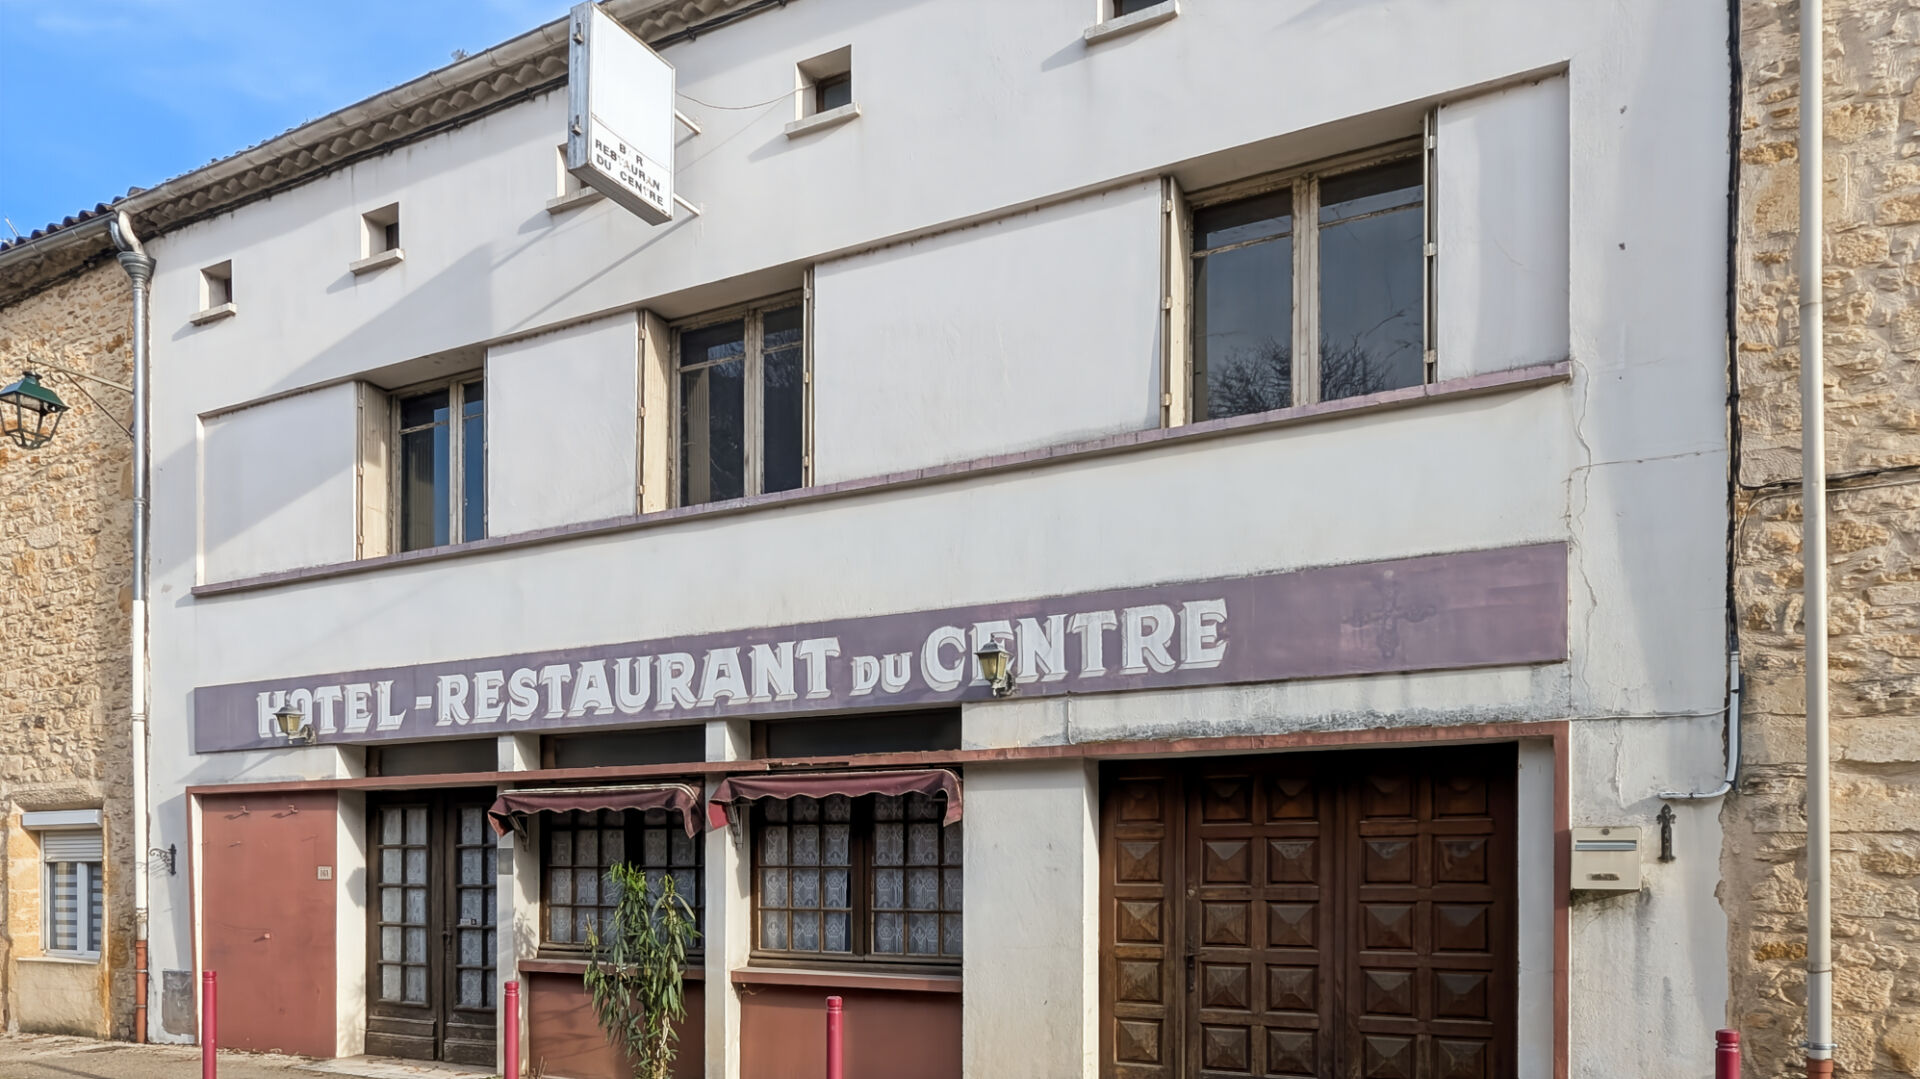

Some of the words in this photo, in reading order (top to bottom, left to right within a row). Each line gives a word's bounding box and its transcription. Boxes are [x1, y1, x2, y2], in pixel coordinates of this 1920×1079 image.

[597, 154, 611, 171] DU
[619, 143, 643, 167] BR
[849, 651, 913, 696] DU
[920, 599, 1229, 693] CENTRE
